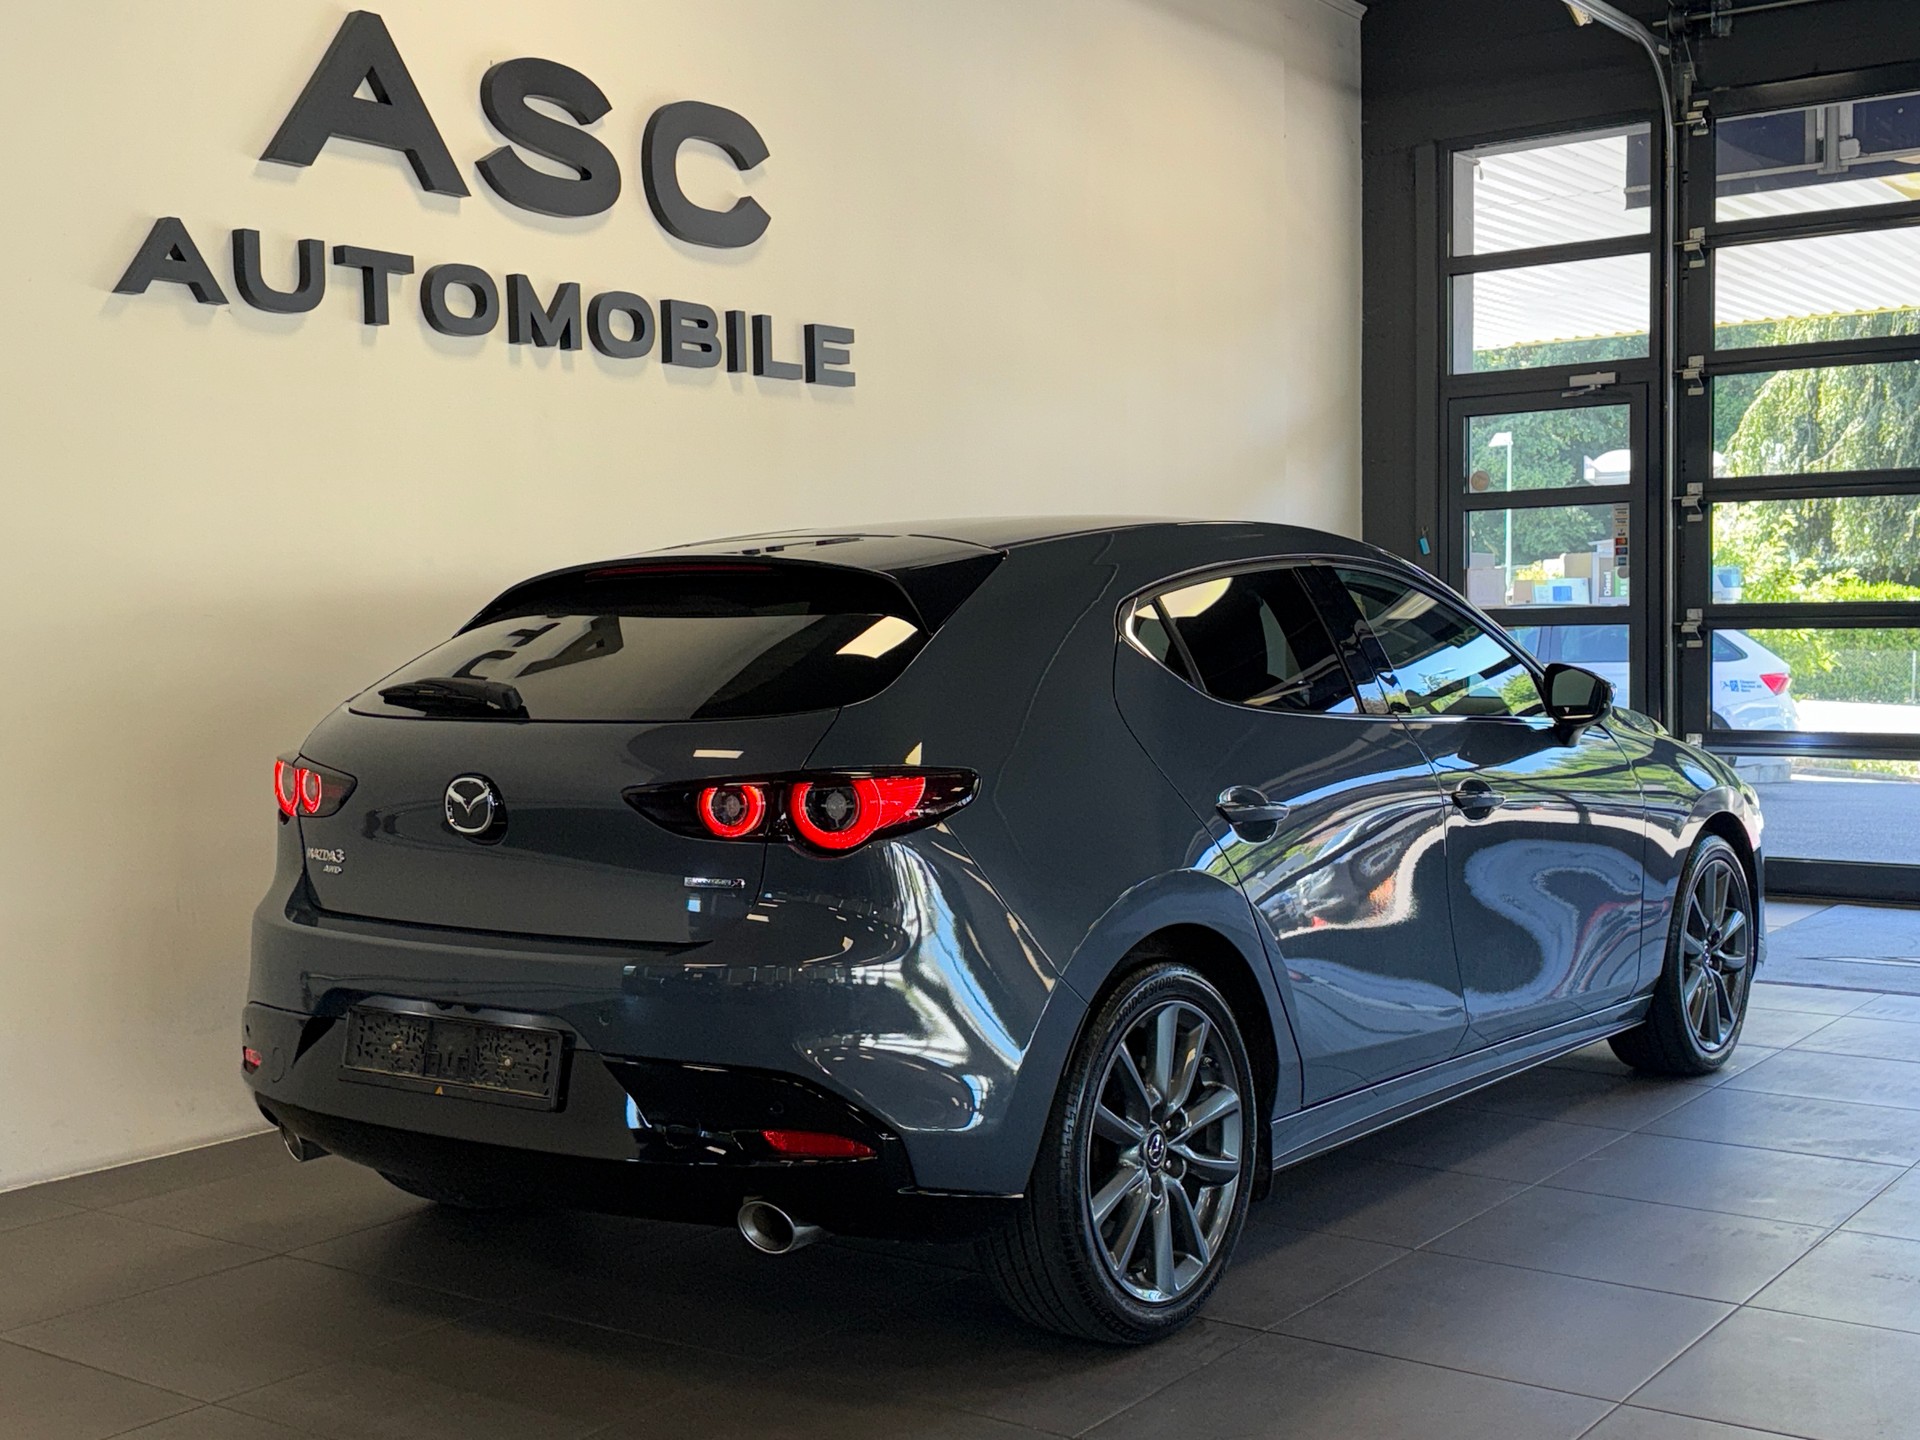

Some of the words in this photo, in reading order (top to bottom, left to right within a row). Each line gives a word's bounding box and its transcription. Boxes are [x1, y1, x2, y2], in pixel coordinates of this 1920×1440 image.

[260, 10, 772, 248] ASC
[112, 217, 857, 387] AUTOMOBILE
[307, 847, 345, 864] MAZDA3
